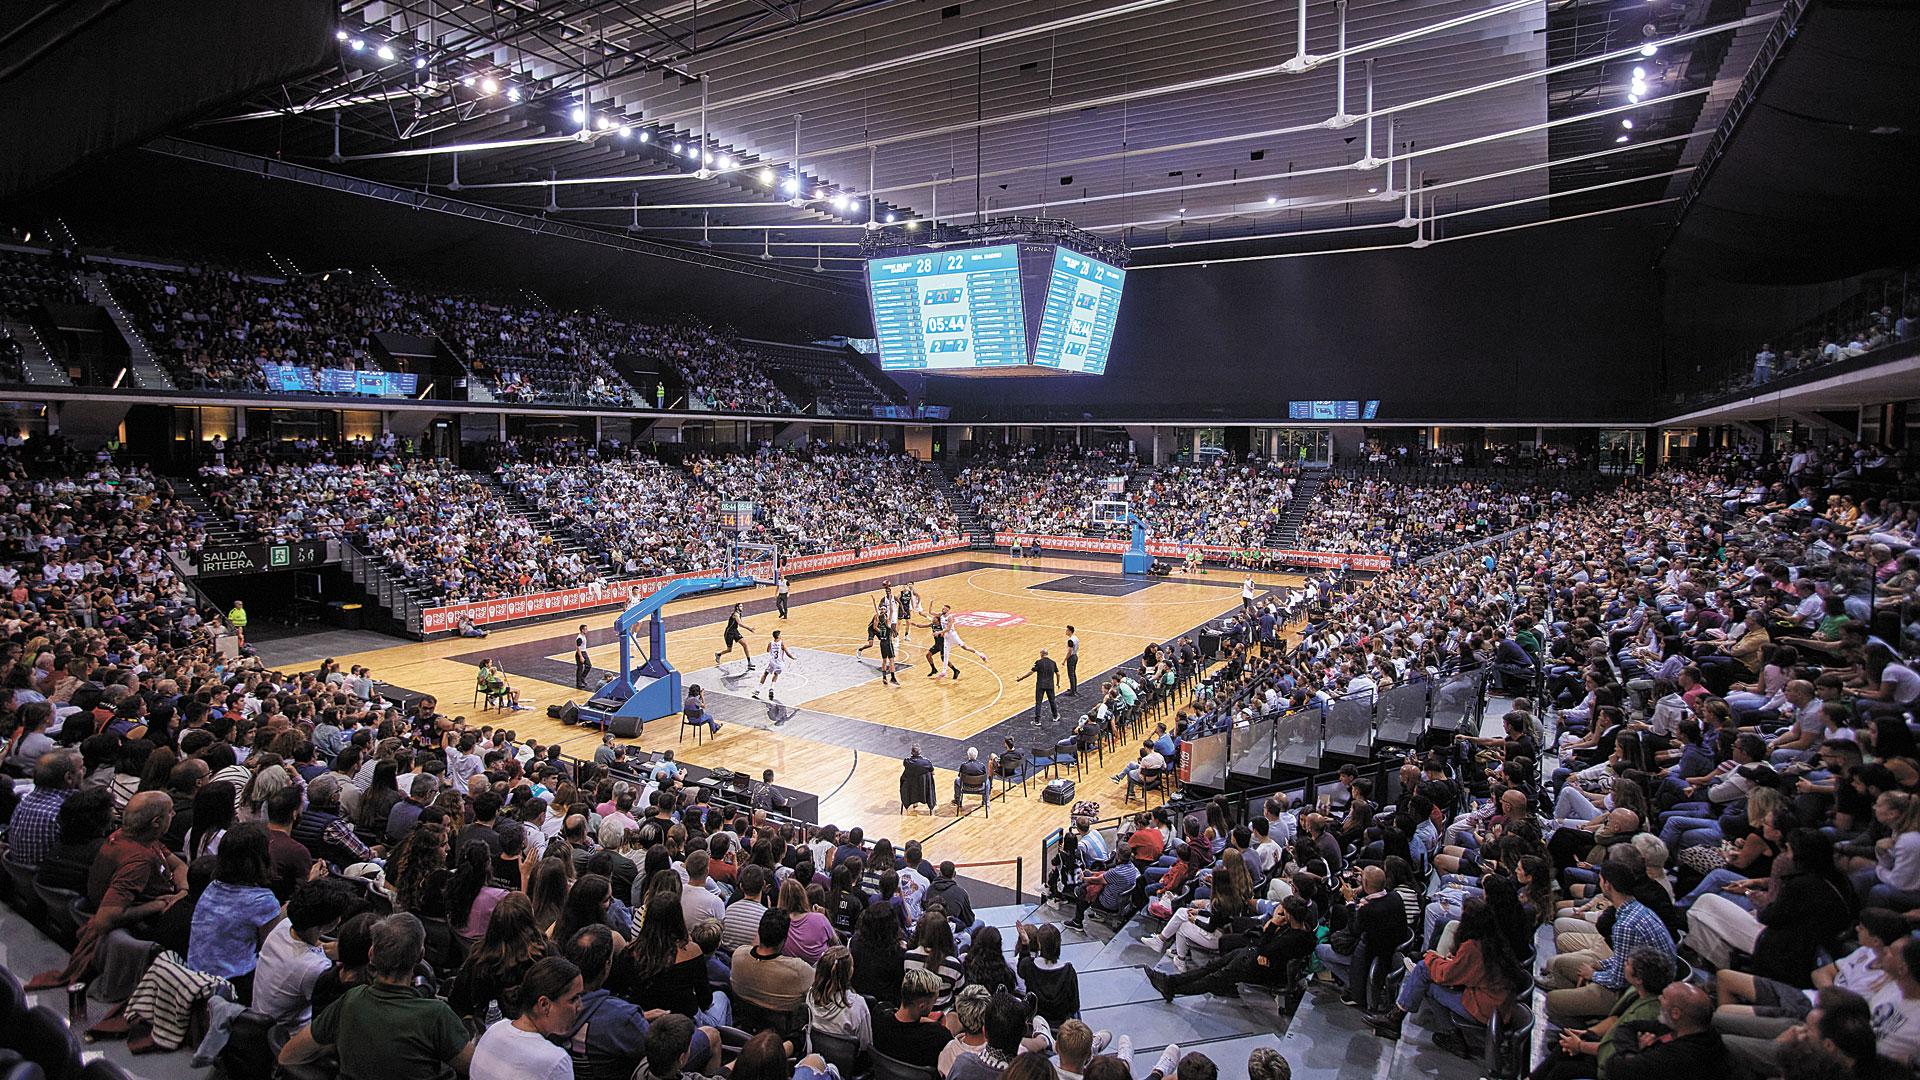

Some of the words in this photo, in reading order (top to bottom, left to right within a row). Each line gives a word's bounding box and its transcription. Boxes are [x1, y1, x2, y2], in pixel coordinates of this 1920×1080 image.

[916, 258, 932, 273] 28
[947, 255, 963, 270] 22
[1079, 261, 1090, 275] 28
[1094, 267, 1105, 281] 22
[929, 316, 966, 332] 05:44
[934, 341, 941, 352] 2
[956, 340, 964, 351] 2
[724, 514, 735, 526] 14
[740, 514, 751, 526] 14
[203, 550, 248, 562] SALIDA
[203, 559, 255, 572] IRTEERA
[773, 650, 779, 659] 3
